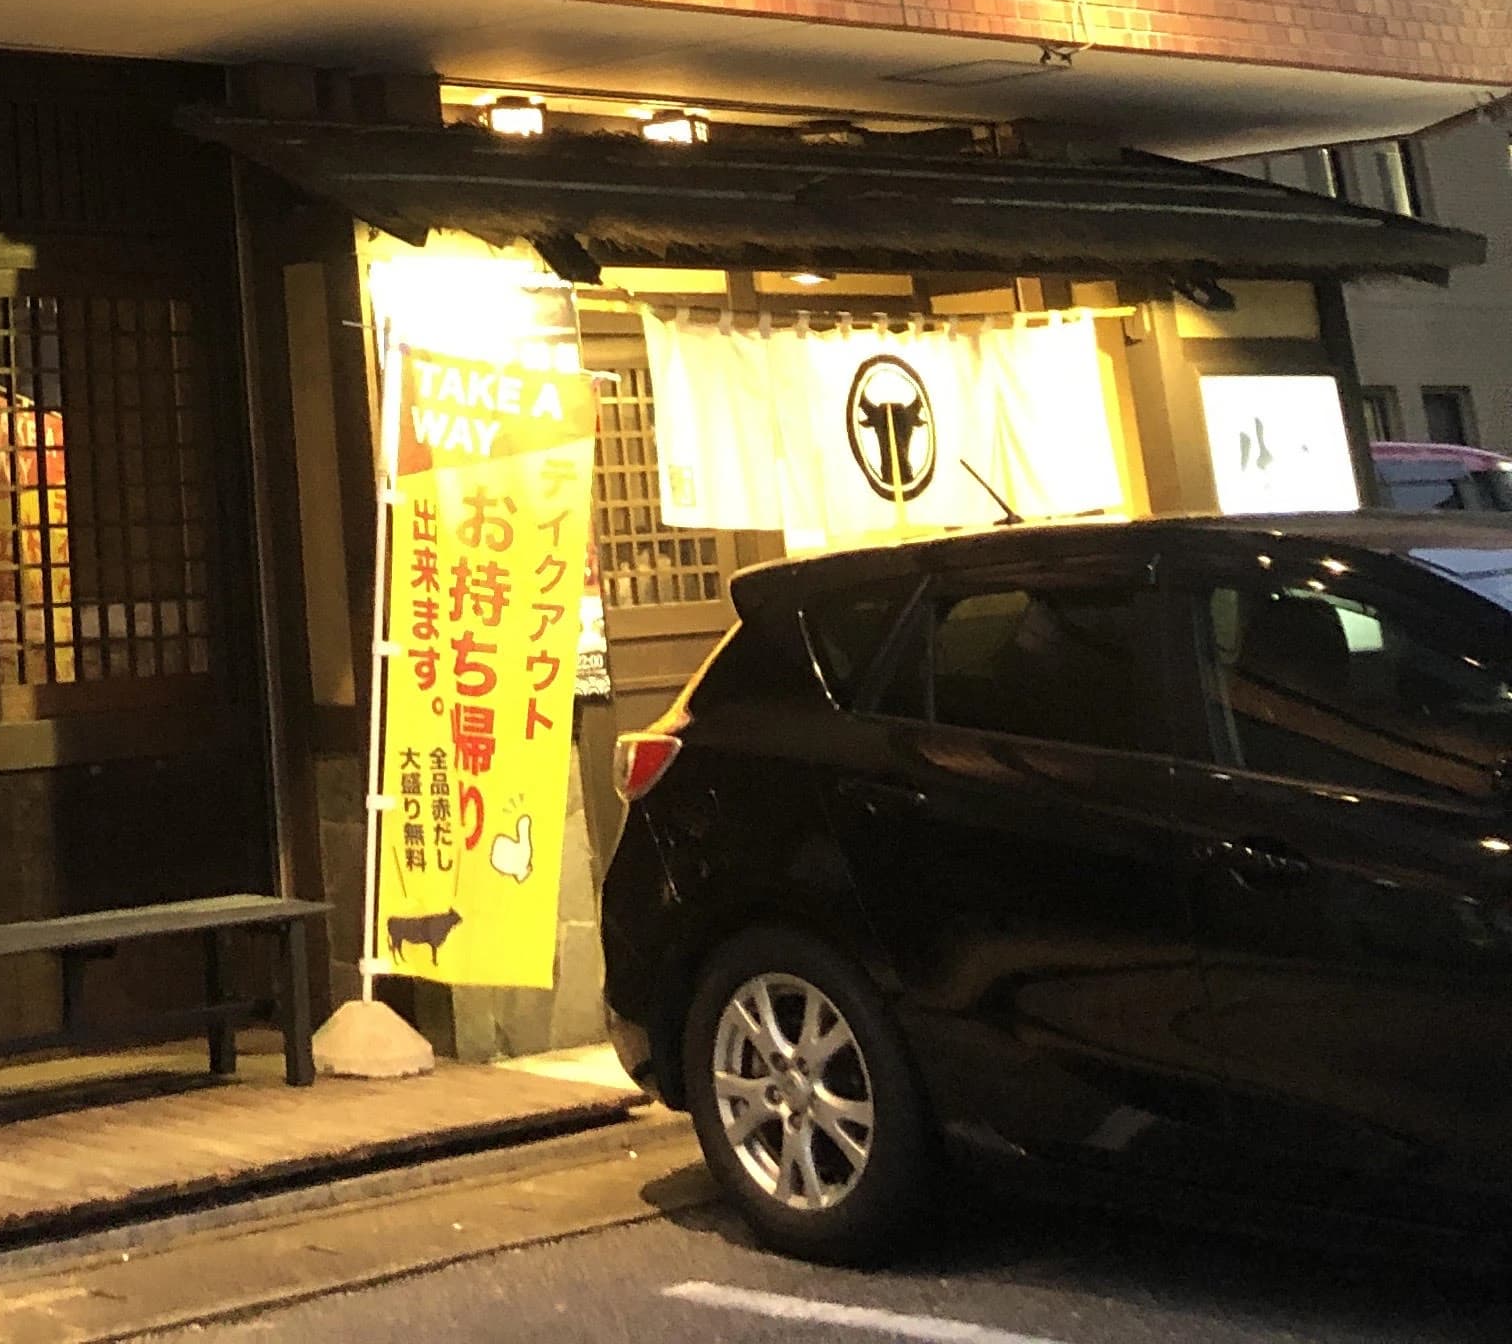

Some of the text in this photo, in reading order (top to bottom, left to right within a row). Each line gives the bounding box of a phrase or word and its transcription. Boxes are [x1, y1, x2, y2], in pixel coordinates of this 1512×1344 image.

[411, 406, 501, 457] WAY
[413, 360, 563, 421] TAKE A
[525, 458, 579, 740] テイクアウト
[448, 485, 518, 850] お持ち帰り
[399, 747, 427, 873] 大盛り無料
[429, 747, 454, 872] 全品赤だし
